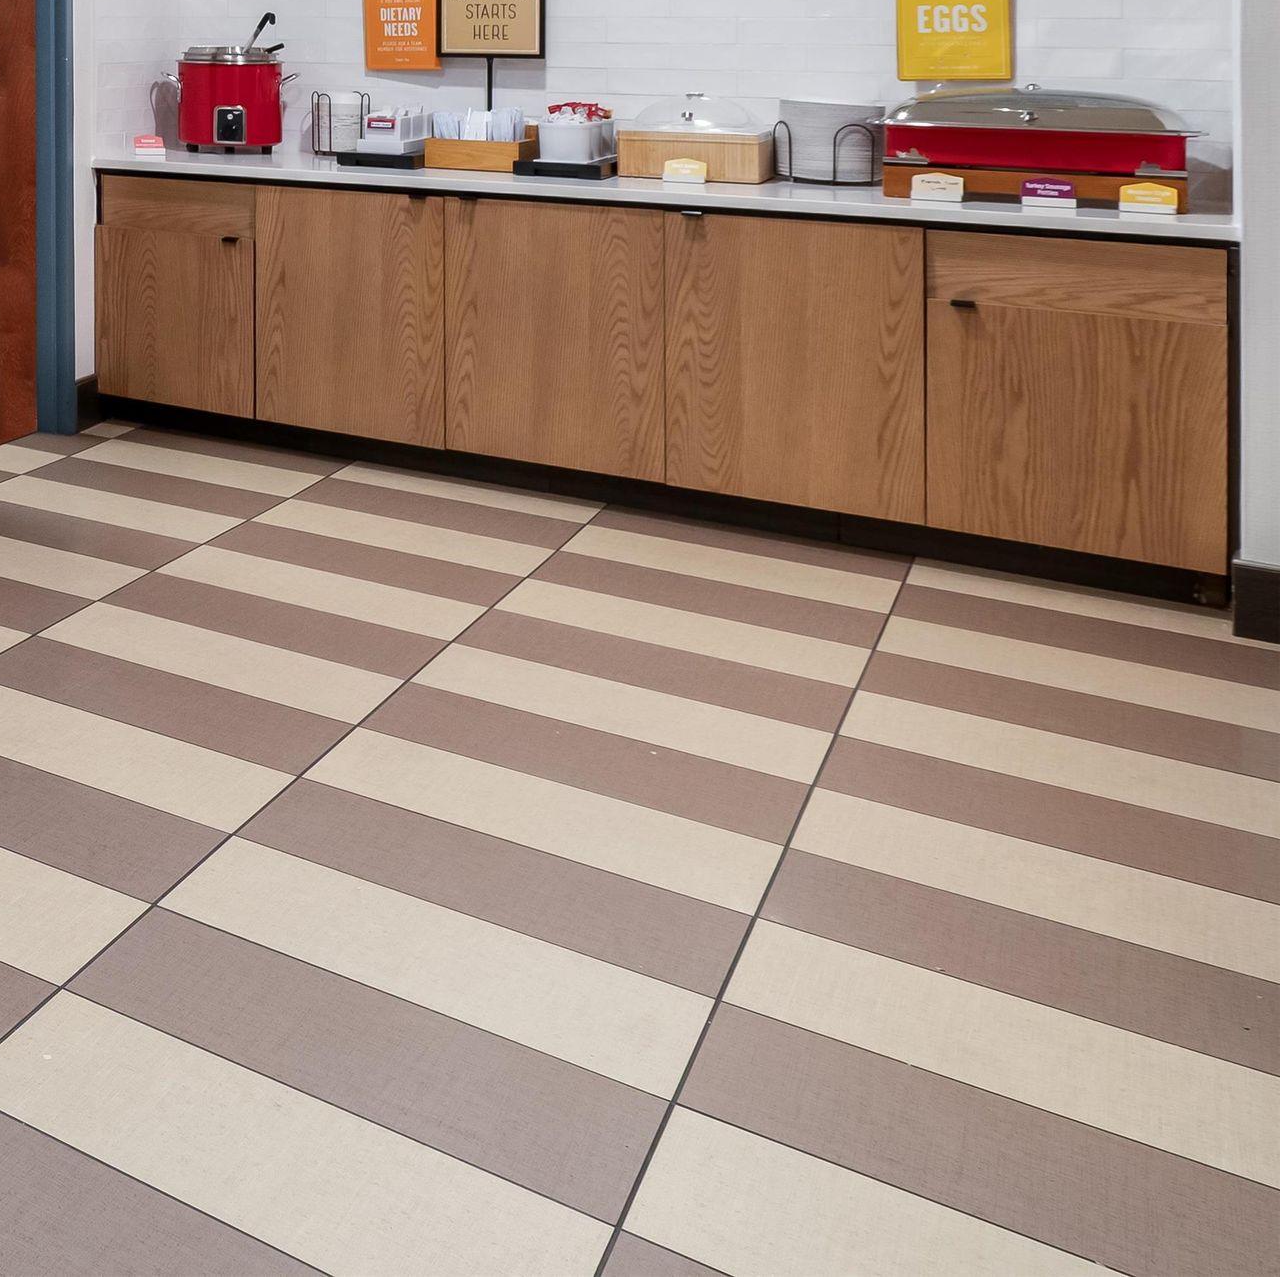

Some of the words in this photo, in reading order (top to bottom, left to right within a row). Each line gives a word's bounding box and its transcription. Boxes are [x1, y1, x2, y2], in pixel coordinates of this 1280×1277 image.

[380, 7, 422, 21] DIETARY
[465, 3, 517, 20] STARTS
[917, 4, 988, 34] EGGS
[384, 22, 418, 37] NEEDS
[473, 24, 509, 41] HERE
